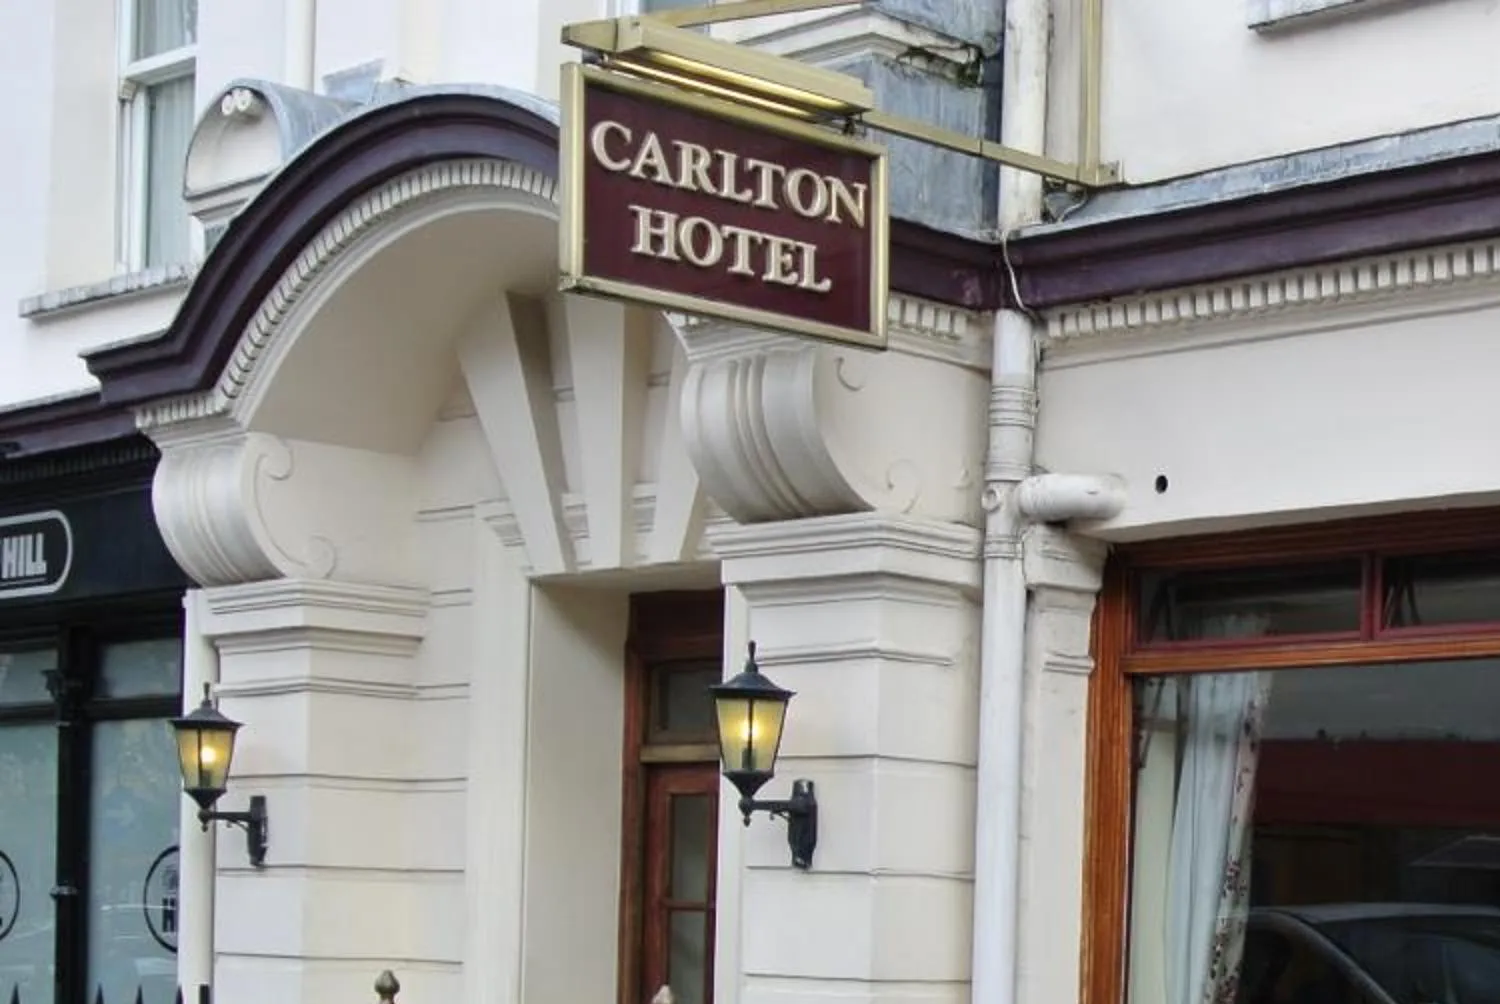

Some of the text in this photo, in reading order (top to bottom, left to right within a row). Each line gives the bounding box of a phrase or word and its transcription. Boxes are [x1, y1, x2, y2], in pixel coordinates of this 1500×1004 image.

[590, 120, 868, 228] CARLTON
[628, 204, 833, 292] HOTEL
[2, 533, 46, 579] HILL
